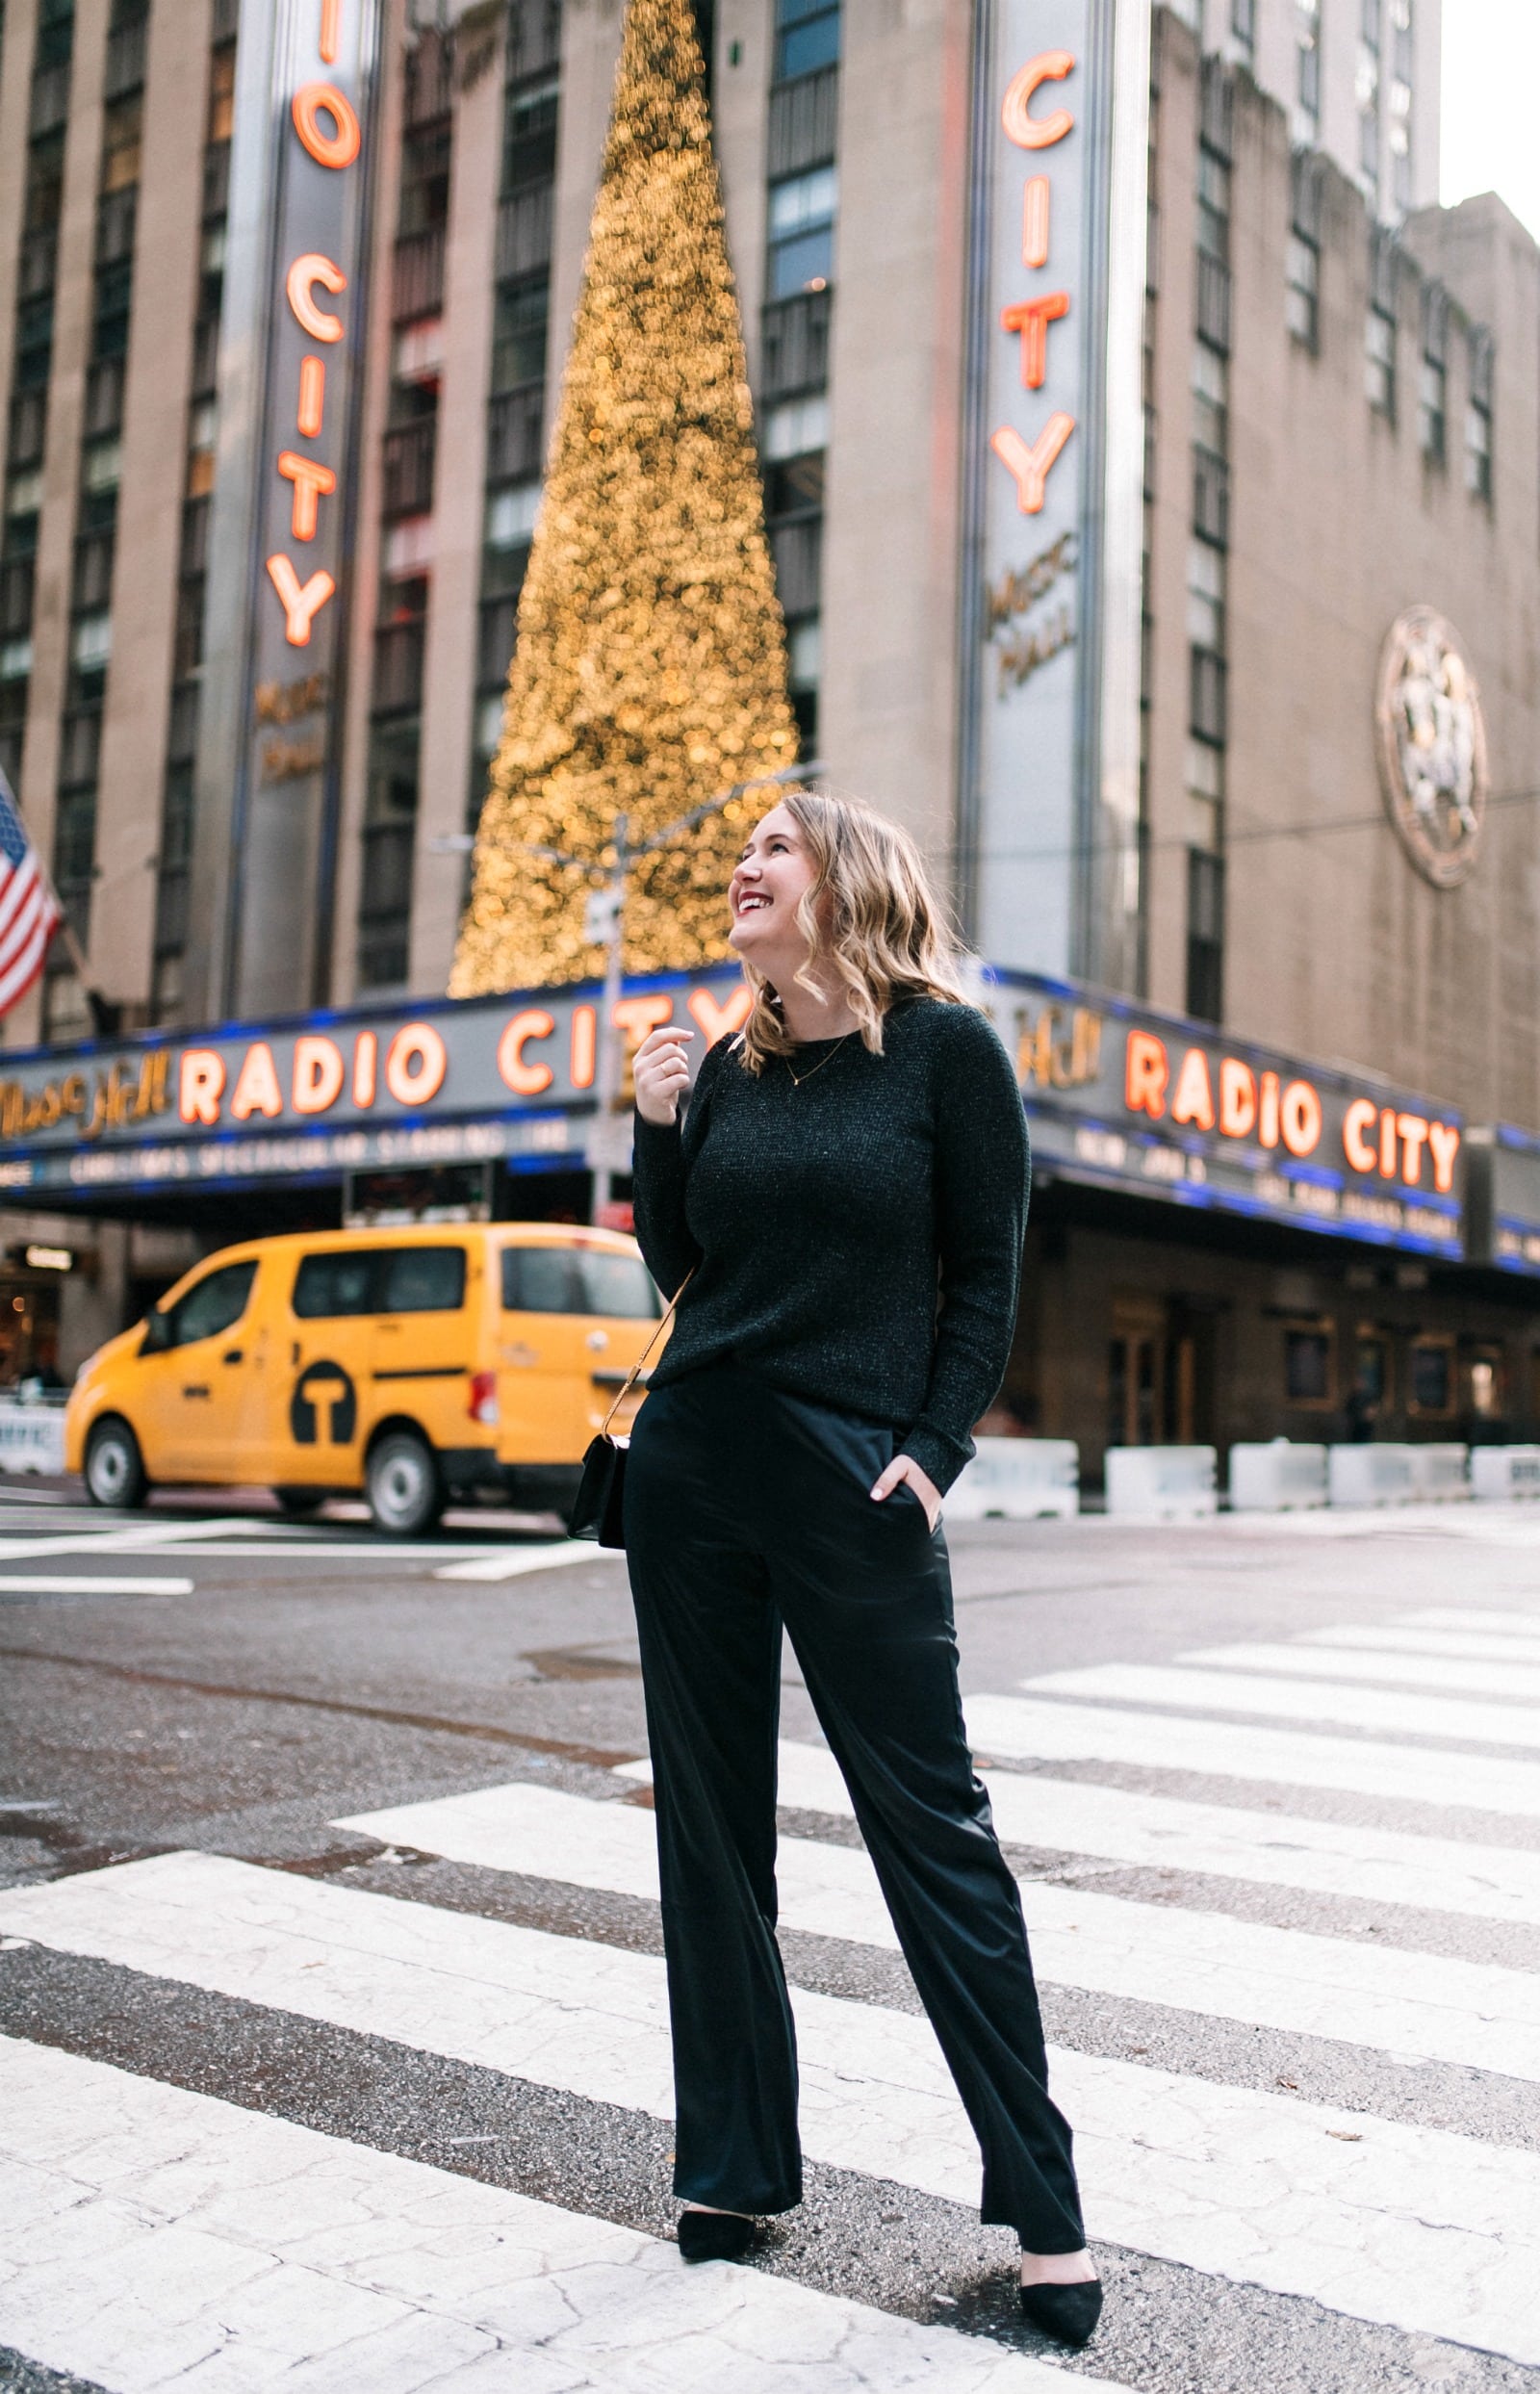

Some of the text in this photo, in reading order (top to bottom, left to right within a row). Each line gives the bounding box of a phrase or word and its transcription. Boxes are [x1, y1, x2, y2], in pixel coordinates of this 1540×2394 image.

[989, 49, 1076, 515] CITY
[266, 253, 346, 647] CITY
[179, 1021, 448, 1126] RADIO
[1124, 1028, 1323, 1157] RADIO
[1343, 1097, 1461, 1194] CITY
